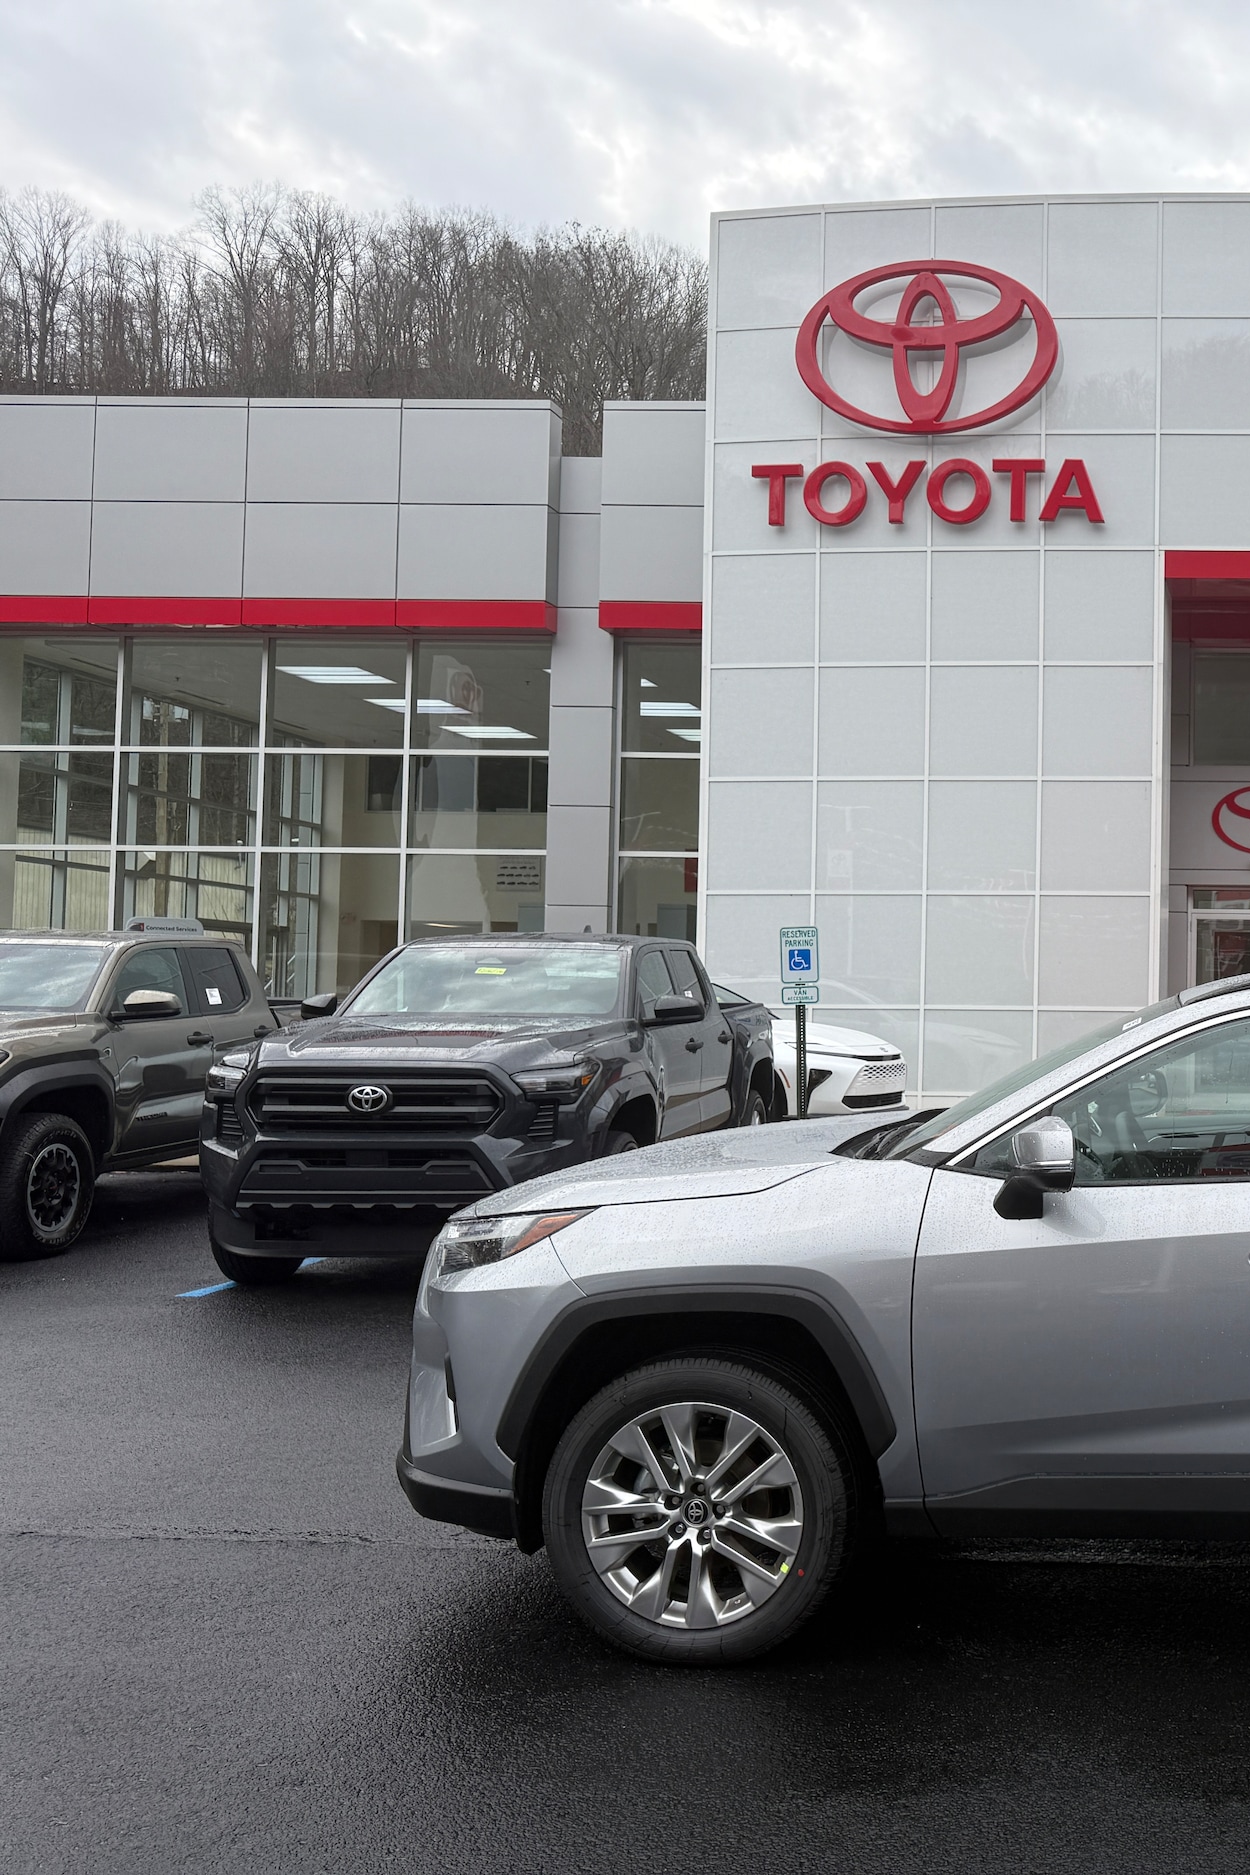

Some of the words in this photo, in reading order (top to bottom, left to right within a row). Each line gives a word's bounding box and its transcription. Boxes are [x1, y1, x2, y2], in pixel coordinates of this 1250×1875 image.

[751, 458, 1105, 528] TOYOTA
[782, 929, 816, 938] RESERVED
[785, 939, 814, 948] PARKING
